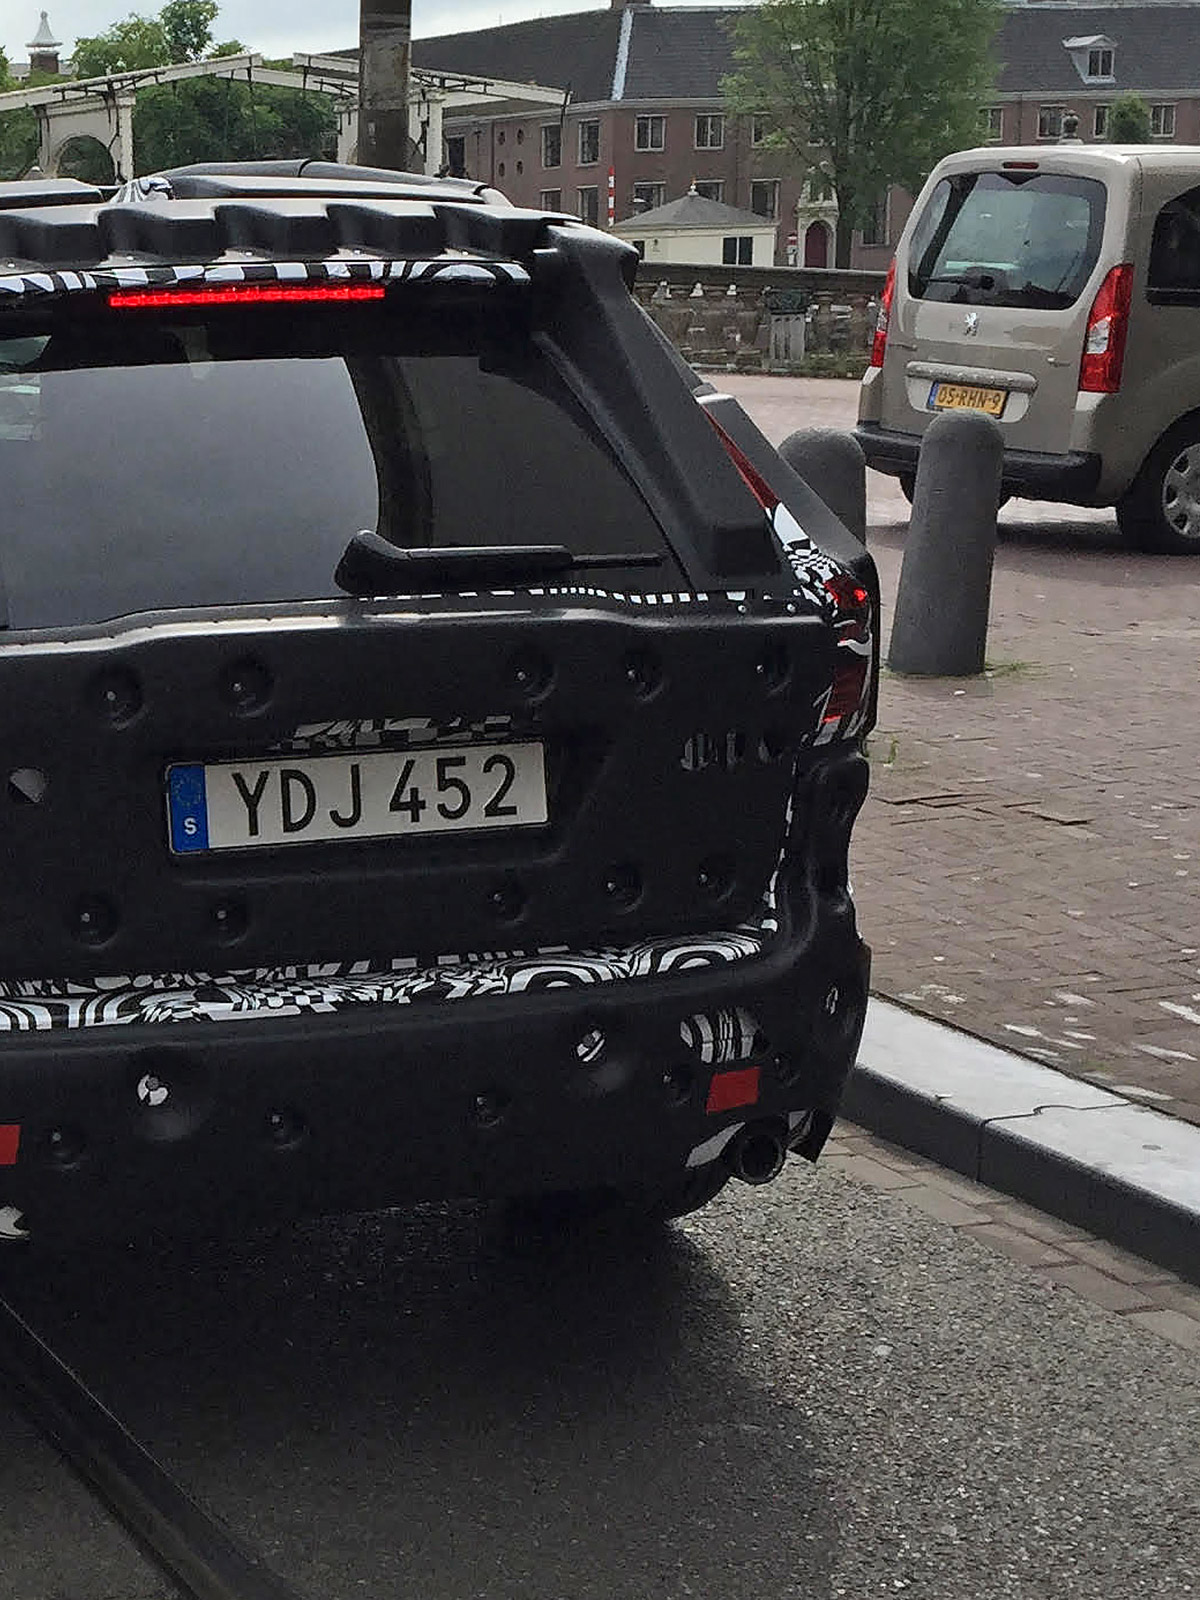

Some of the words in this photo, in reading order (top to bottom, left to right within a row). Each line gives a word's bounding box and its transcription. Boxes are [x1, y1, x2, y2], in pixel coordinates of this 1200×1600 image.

[937, 387, 1001, 410] 05-RHN-9
[232, 764, 361, 837] YDJ
[389, 754, 518, 823] 452
[184, 816, 198, 835] S
